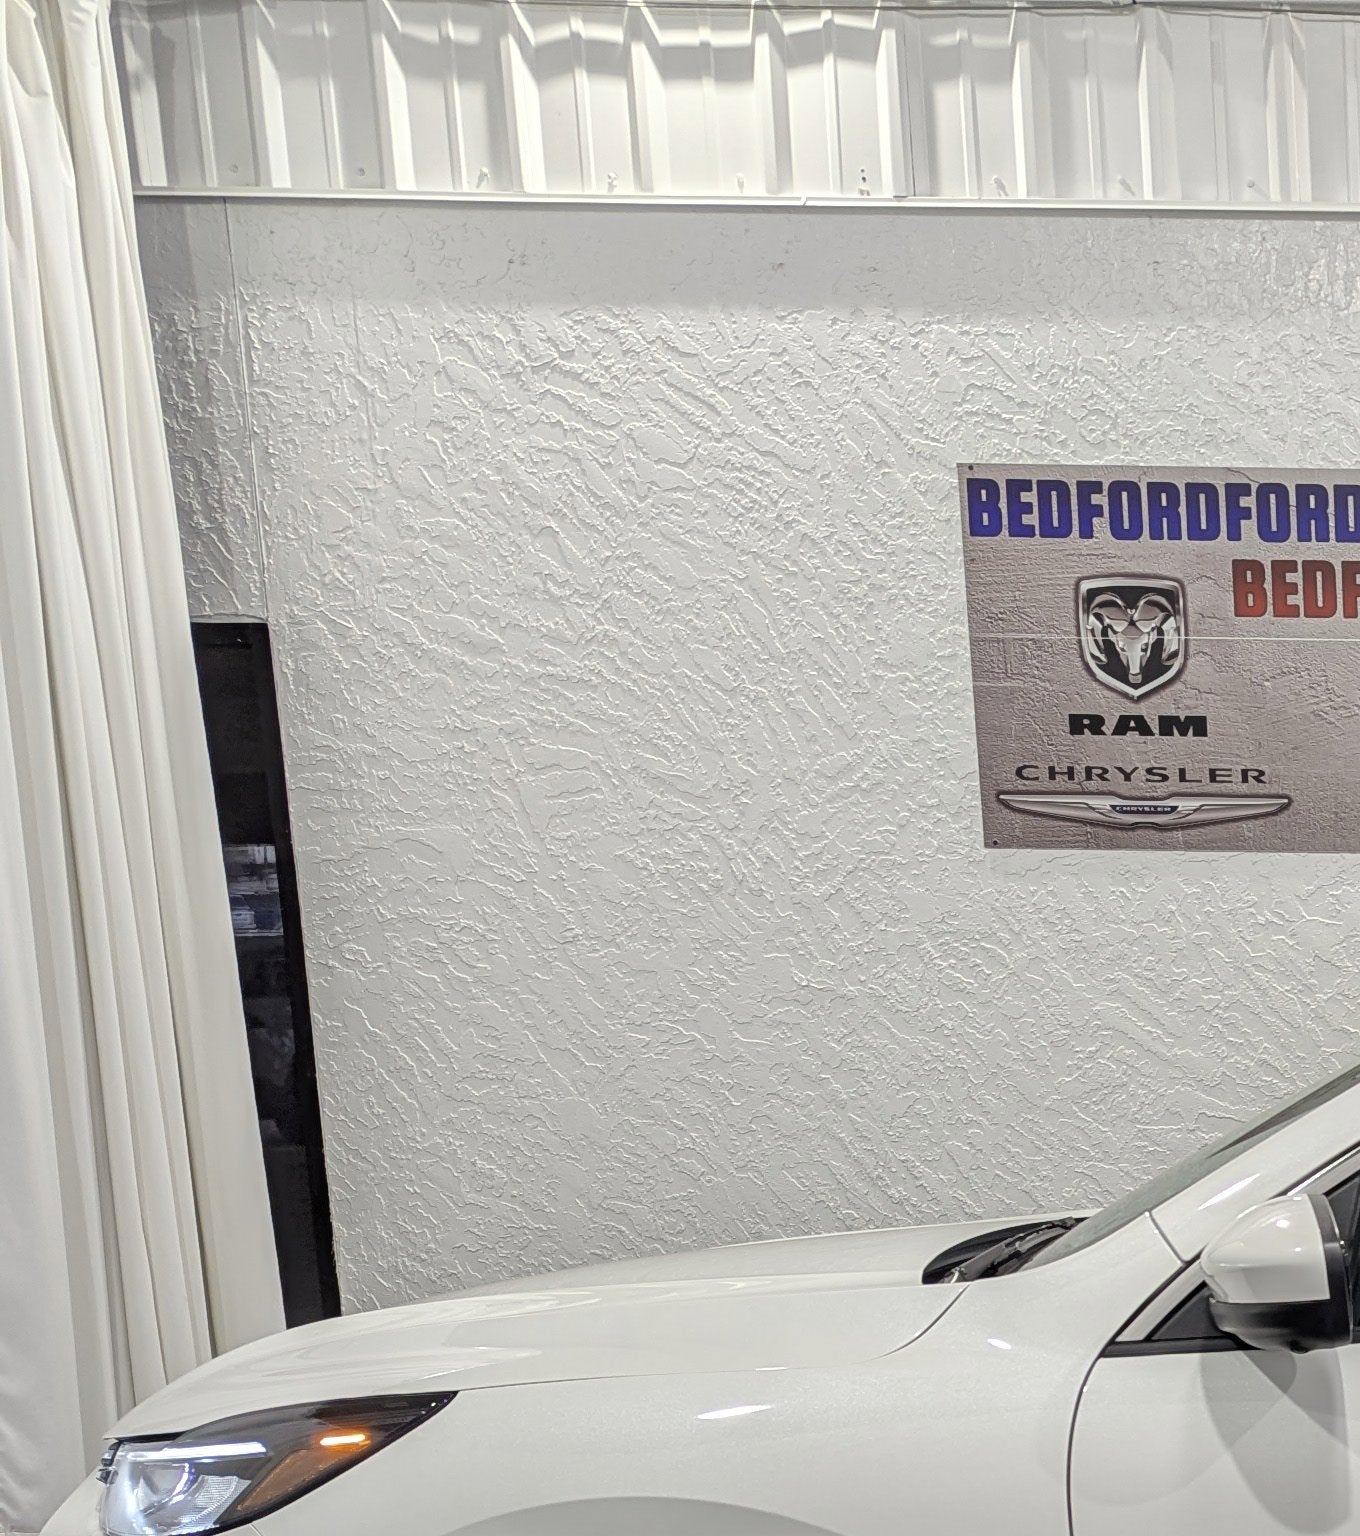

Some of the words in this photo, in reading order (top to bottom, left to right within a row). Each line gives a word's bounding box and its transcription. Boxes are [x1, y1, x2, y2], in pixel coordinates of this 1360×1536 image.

[1068, 713, 1209, 738] RAM
[1015, 764, 1268, 785] CHRYSLER
[1115, 805, 1172, 813] CHRYSLER
